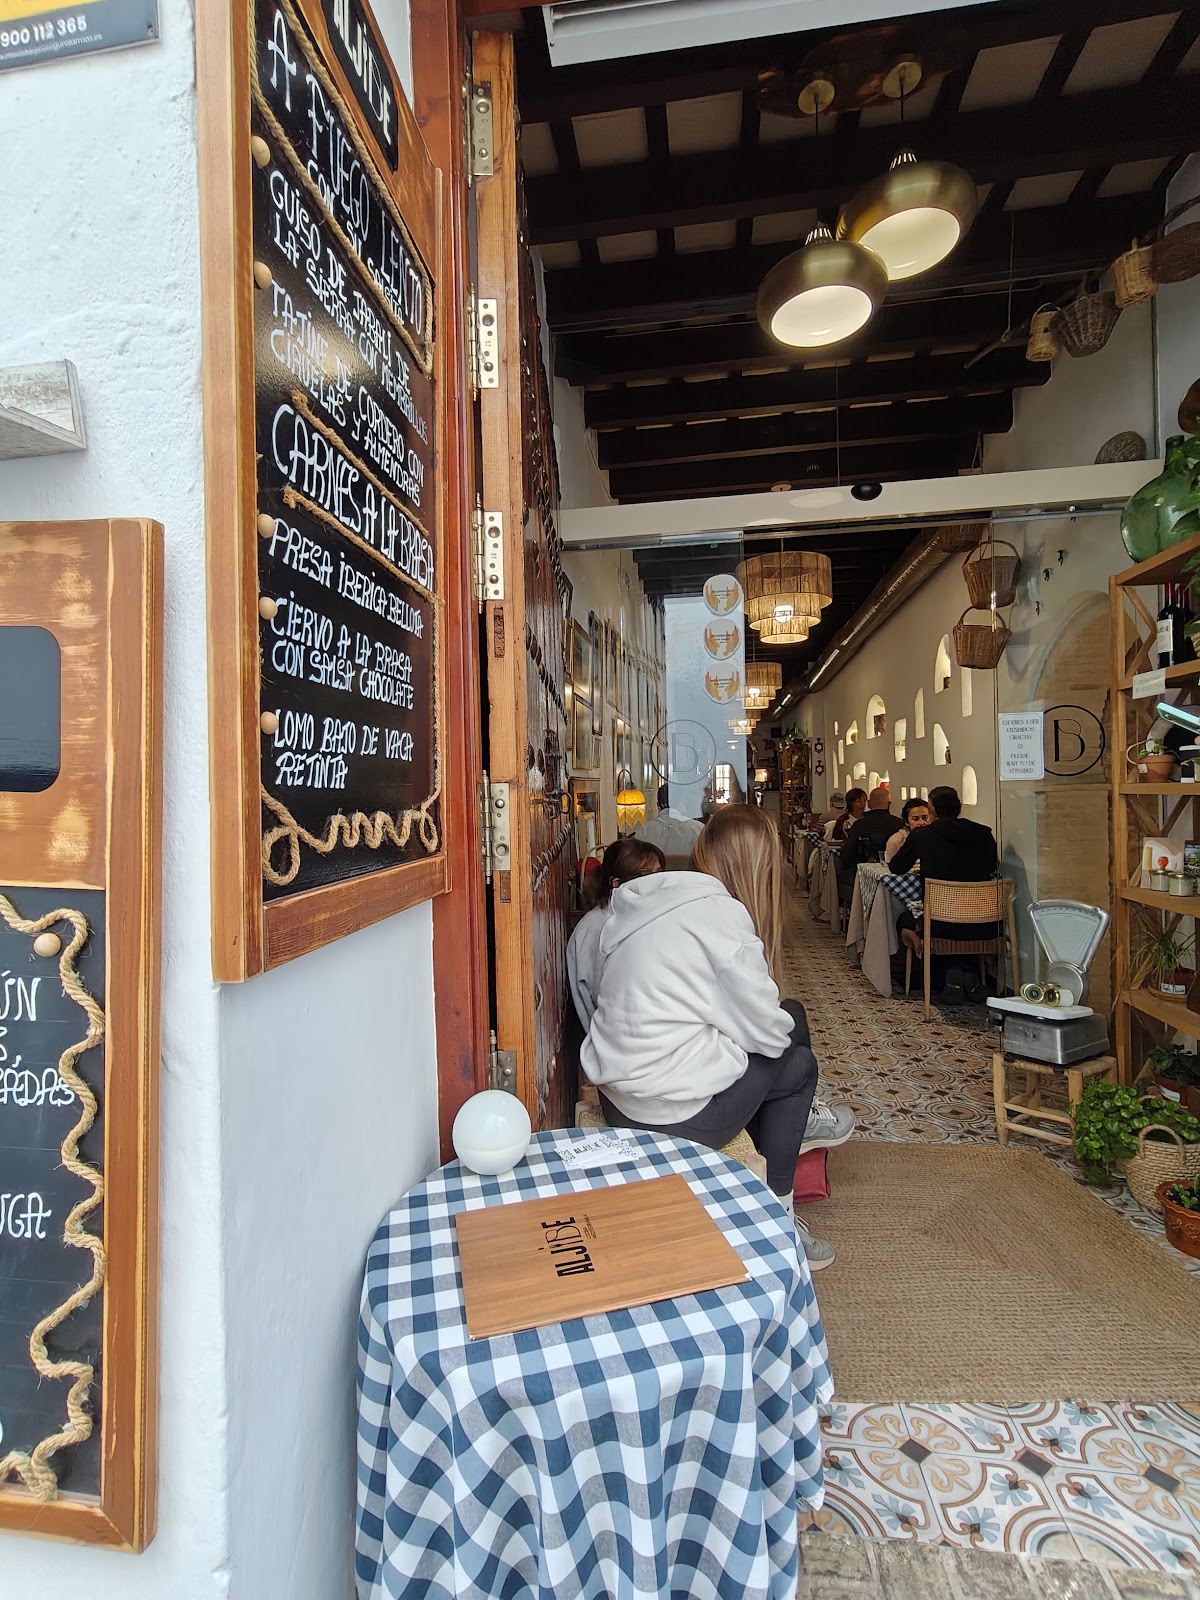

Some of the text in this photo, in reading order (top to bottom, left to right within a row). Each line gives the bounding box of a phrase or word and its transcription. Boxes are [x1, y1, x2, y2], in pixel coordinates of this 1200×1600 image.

[0, 14, 88, 48] 900 112 365
[268, 9, 422, 335] A FUEGO LENTO
[274, 212, 300, 268] LA
[359, 332, 378, 375] CON
[327, 247, 347, 303] DE
[396, 351, 410, 395] DE
[335, 355, 352, 402] DE
[358, 386, 405, 463] CORDERO
[407, 450, 424, 488] CON
[364, 428, 421, 508] ALMENDRAS
[272, 404, 434, 592] CARNES A LA BRASA
[268, 518, 333, 589] PRESA
[387, 592, 424, 639] BELLOTA
[272, 639, 414, 710] CON SALSA CHOCOLATE
[337, 624, 351, 659] A
[355, 632, 372, 668] LA
[374, 641, 412, 683] BRASA
[274, 709, 414, 762] LOMO BAJO DE VACA
[0, 1067, 75, 1107] ADAS
